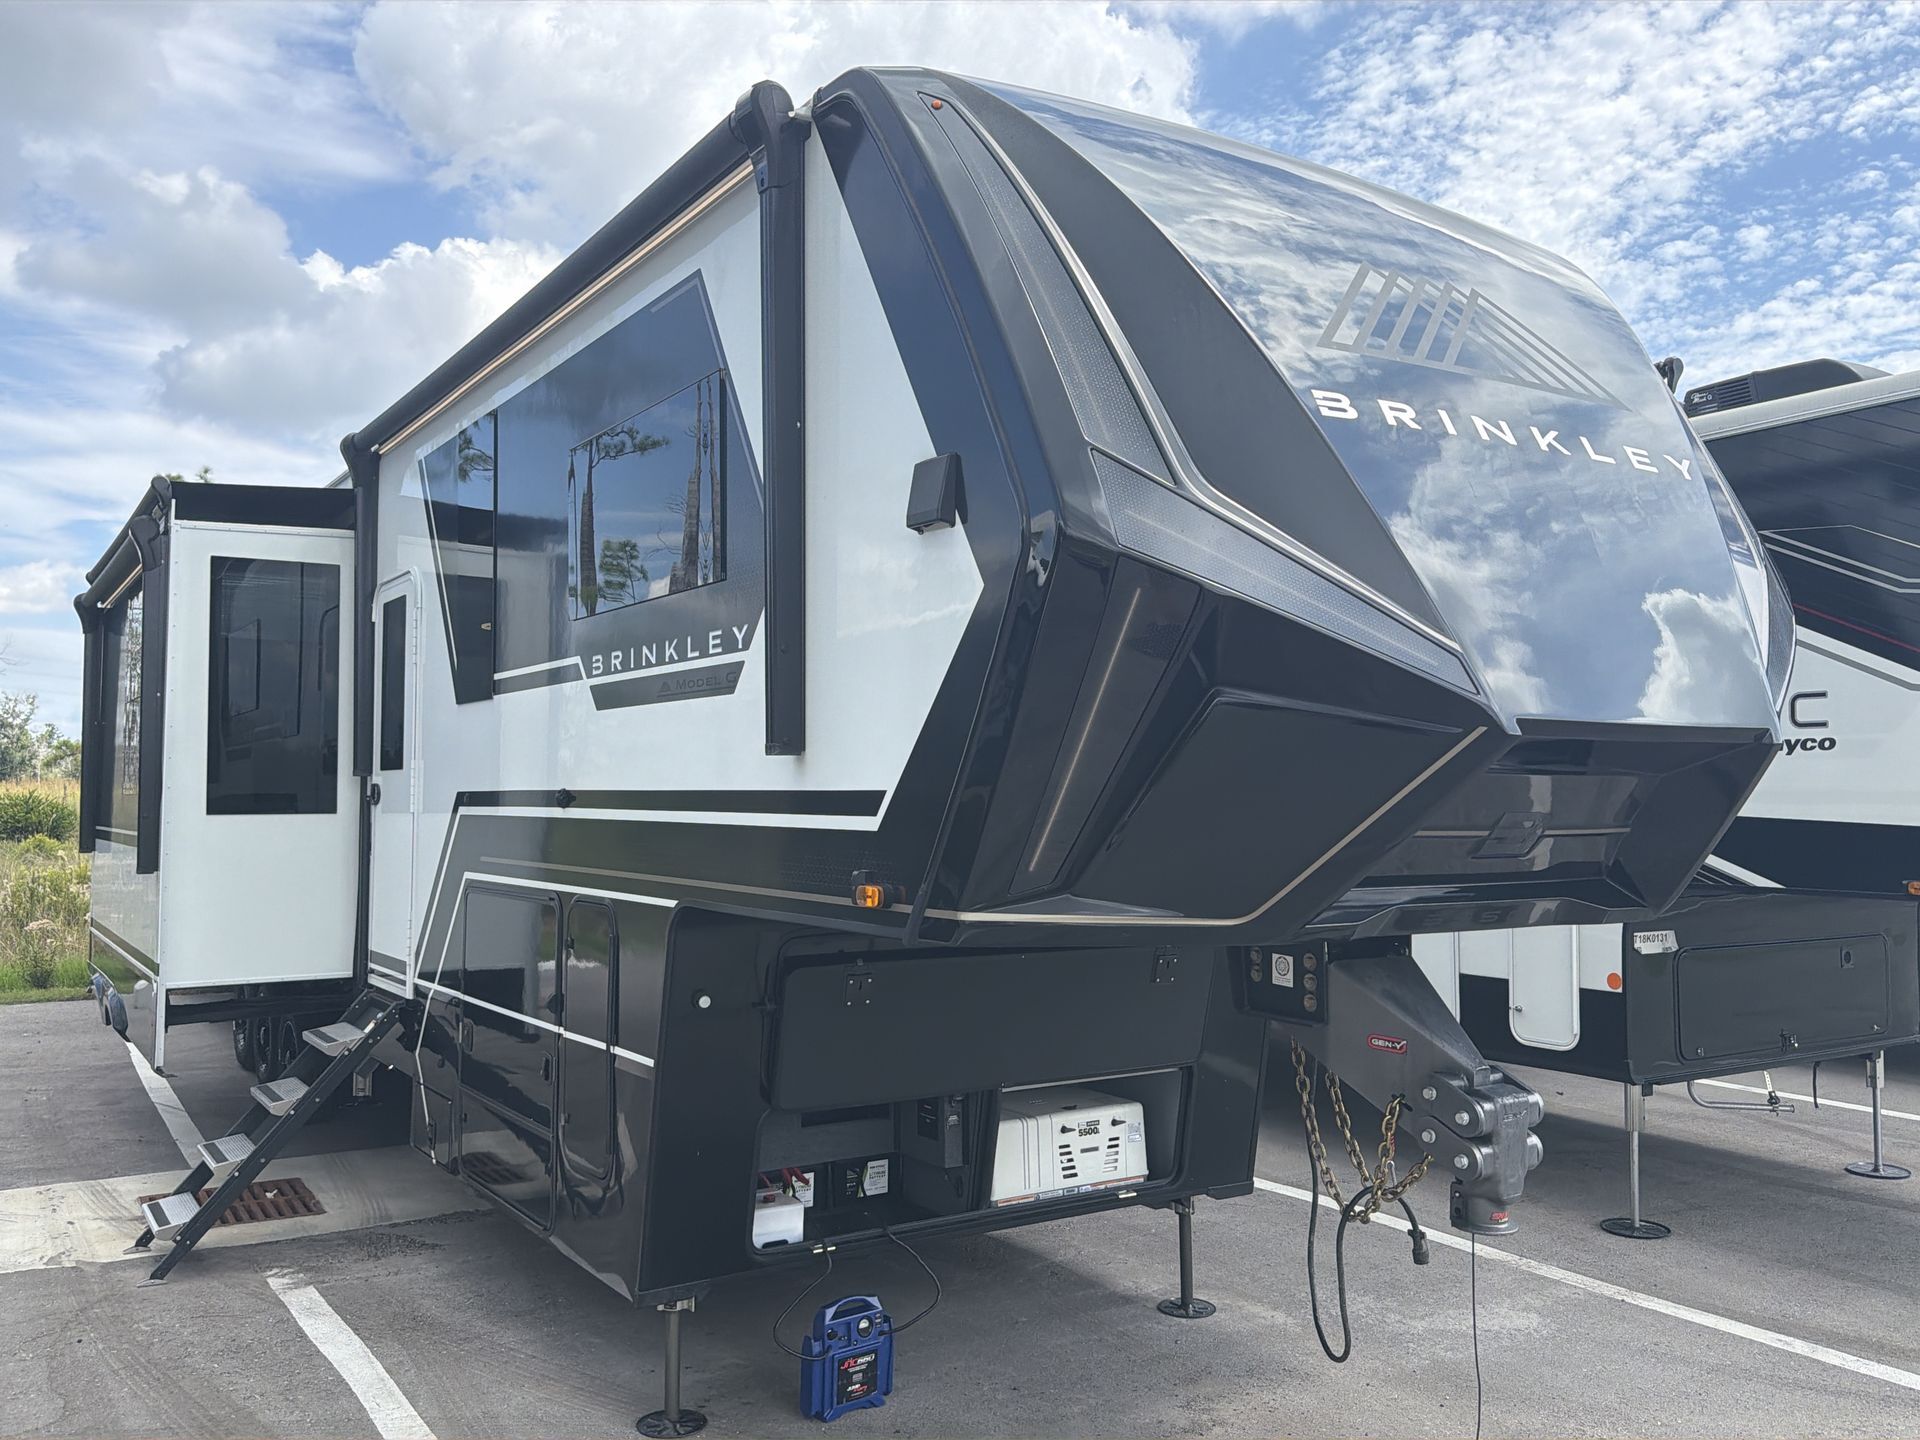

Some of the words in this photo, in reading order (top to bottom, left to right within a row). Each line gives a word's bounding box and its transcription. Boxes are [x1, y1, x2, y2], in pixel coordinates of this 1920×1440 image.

[1311, 389, 1692, 480] BRINKLEY
[592, 624, 749, 675] BRINKLEY
[1780, 737, 1837, 756] yco
[1371, 1038, 1407, 1050] GEN-Y
